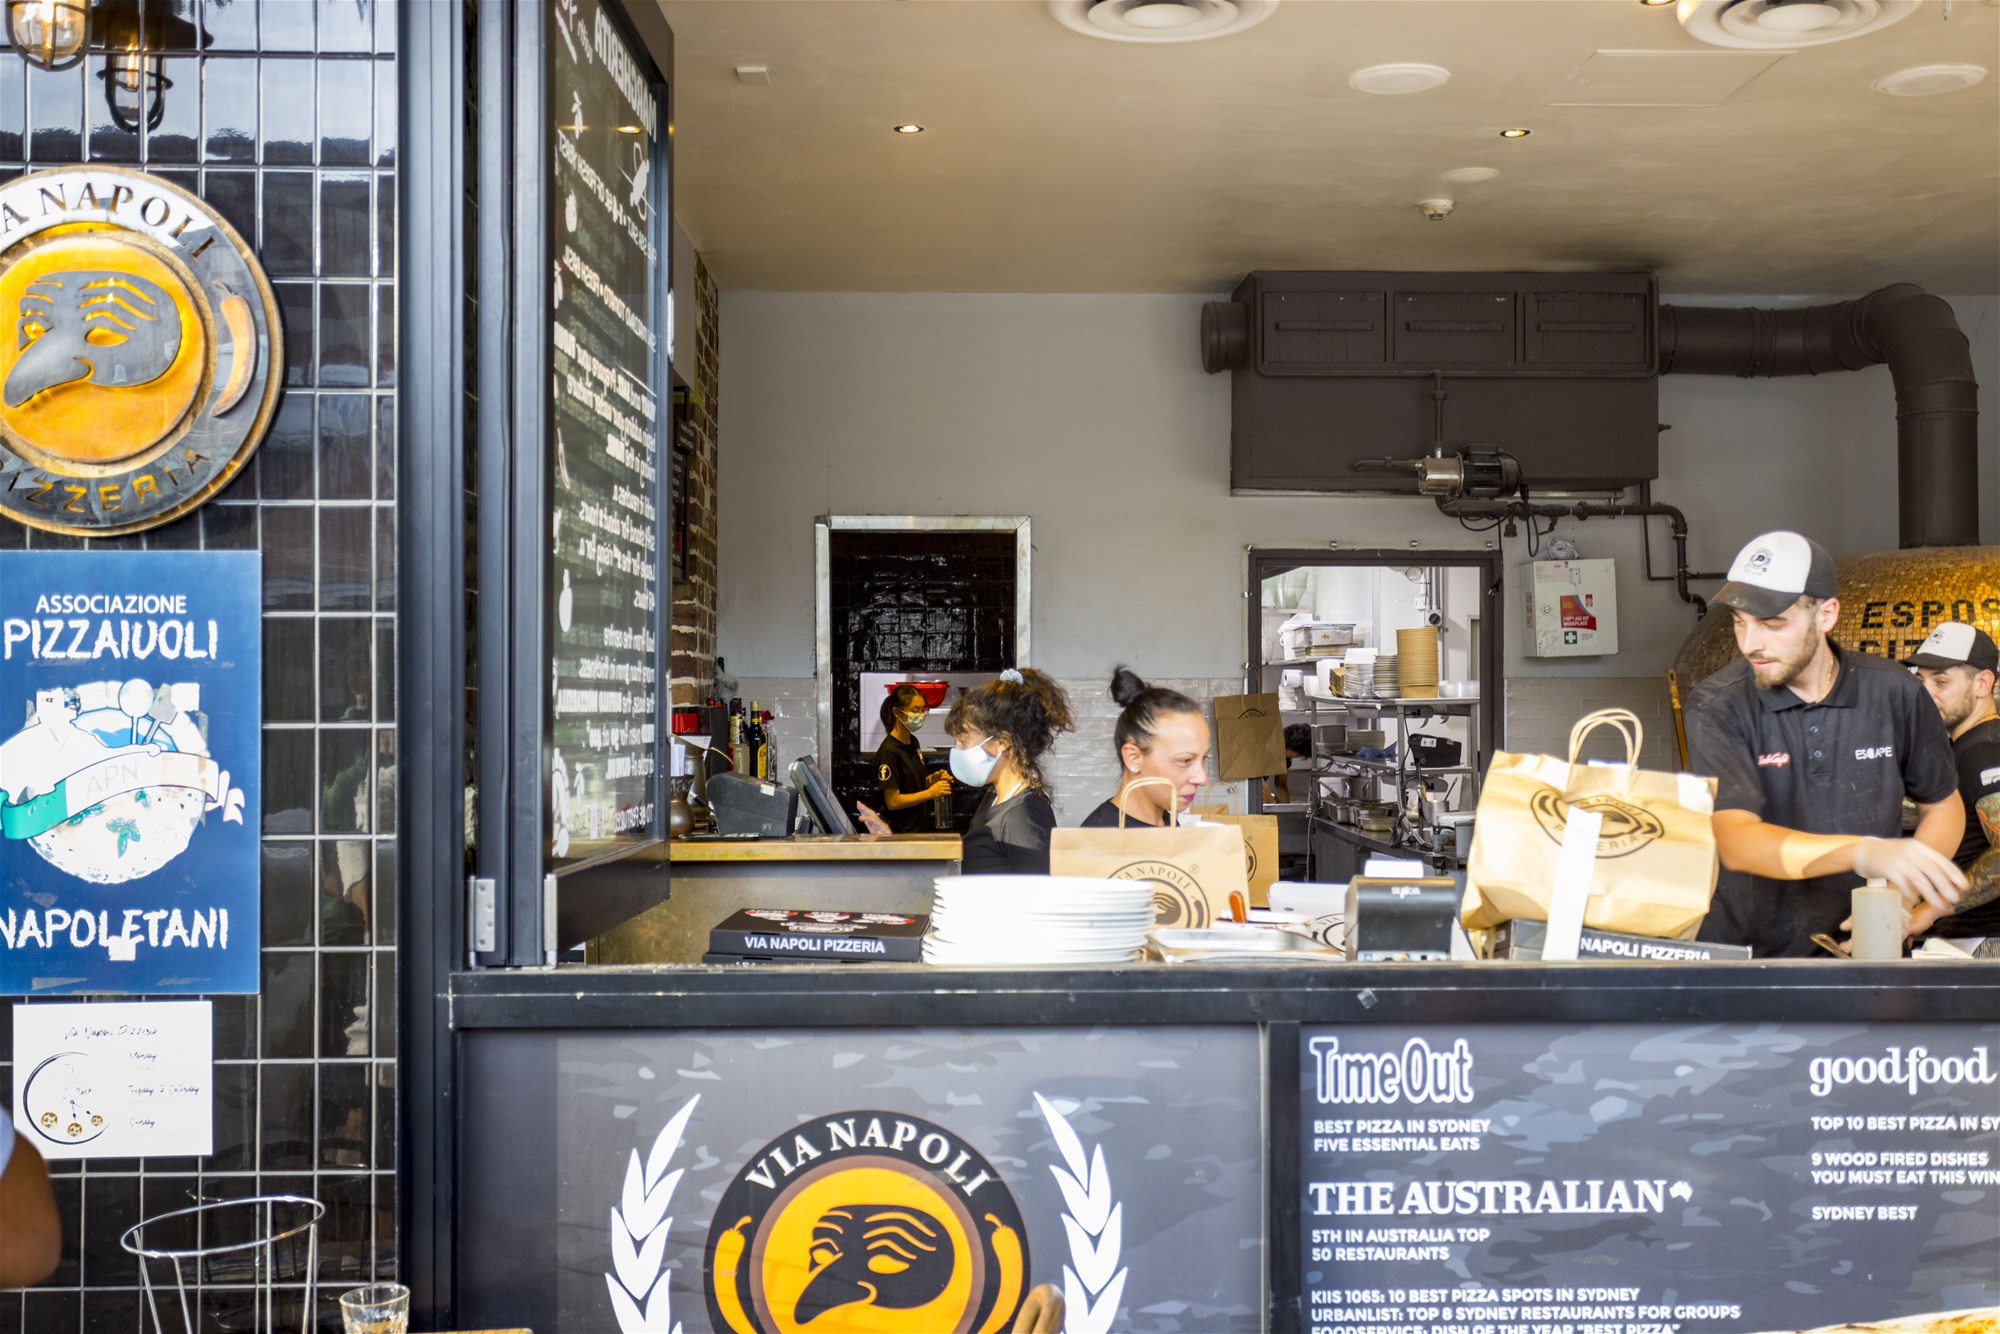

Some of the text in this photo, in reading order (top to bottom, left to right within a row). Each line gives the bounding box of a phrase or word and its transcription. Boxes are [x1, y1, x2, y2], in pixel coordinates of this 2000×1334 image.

[39, 182, 218, 262] NAPOLI
[0, 448, 210, 514] IZZERIA
[35, 593, 188, 615] ASSOCIAZIONE
[3, 618, 219, 661] PIZZAIUOLI
[1135, 866, 1192, 890] NAPOLI
[0, 907, 229, 951] NAPOLETANI
[744, 936, 885, 954] VIA NAPOLI PIZZERIA
[1580, 937, 1638, 958] NAPOLI
[1314, 1119, 1492, 1134] BEST PIZZA IN SYDNEY
[1811, 1116, 2000, 1131] TOP 10 BEST PIZZA IN SY
[1314, 1136, 1480, 1152] FIVE ESSENTIAL EATS
[745, 1117, 992, 1198] VIA NAPOLI
[1812, 1151, 1990, 1166] 9 WOOD FIRED DISHES
[1811, 1170, 2000, 1184] YOU MUST EAT THIS WIN
[1309, 1179, 1669, 1216] THE AUSTRALIAN
[1812, 1206, 1919, 1221] SYDNEY BEST
[1312, 1228, 1491, 1244] 5TH IN AUSTRALIA TOP
[1312, 1246, 1450, 1262] 50 RESTAURANTS
[1311, 1287, 1640, 1304] KIIS 1065: 10 BEST PIZZA SPOTS IN SYDNEY
[1311, 1304, 1742, 1322] URBANLIST: TOP 8 SYDNEY RESTAURANTS FOR GROUPS
[1431, 1325, 1470, 1334] DISH
[1473, 1325, 1496, 1334] OF
[1498, 1324, 1529, 1334] THE
[1531, 1324, 1574, 1334] YEAR
